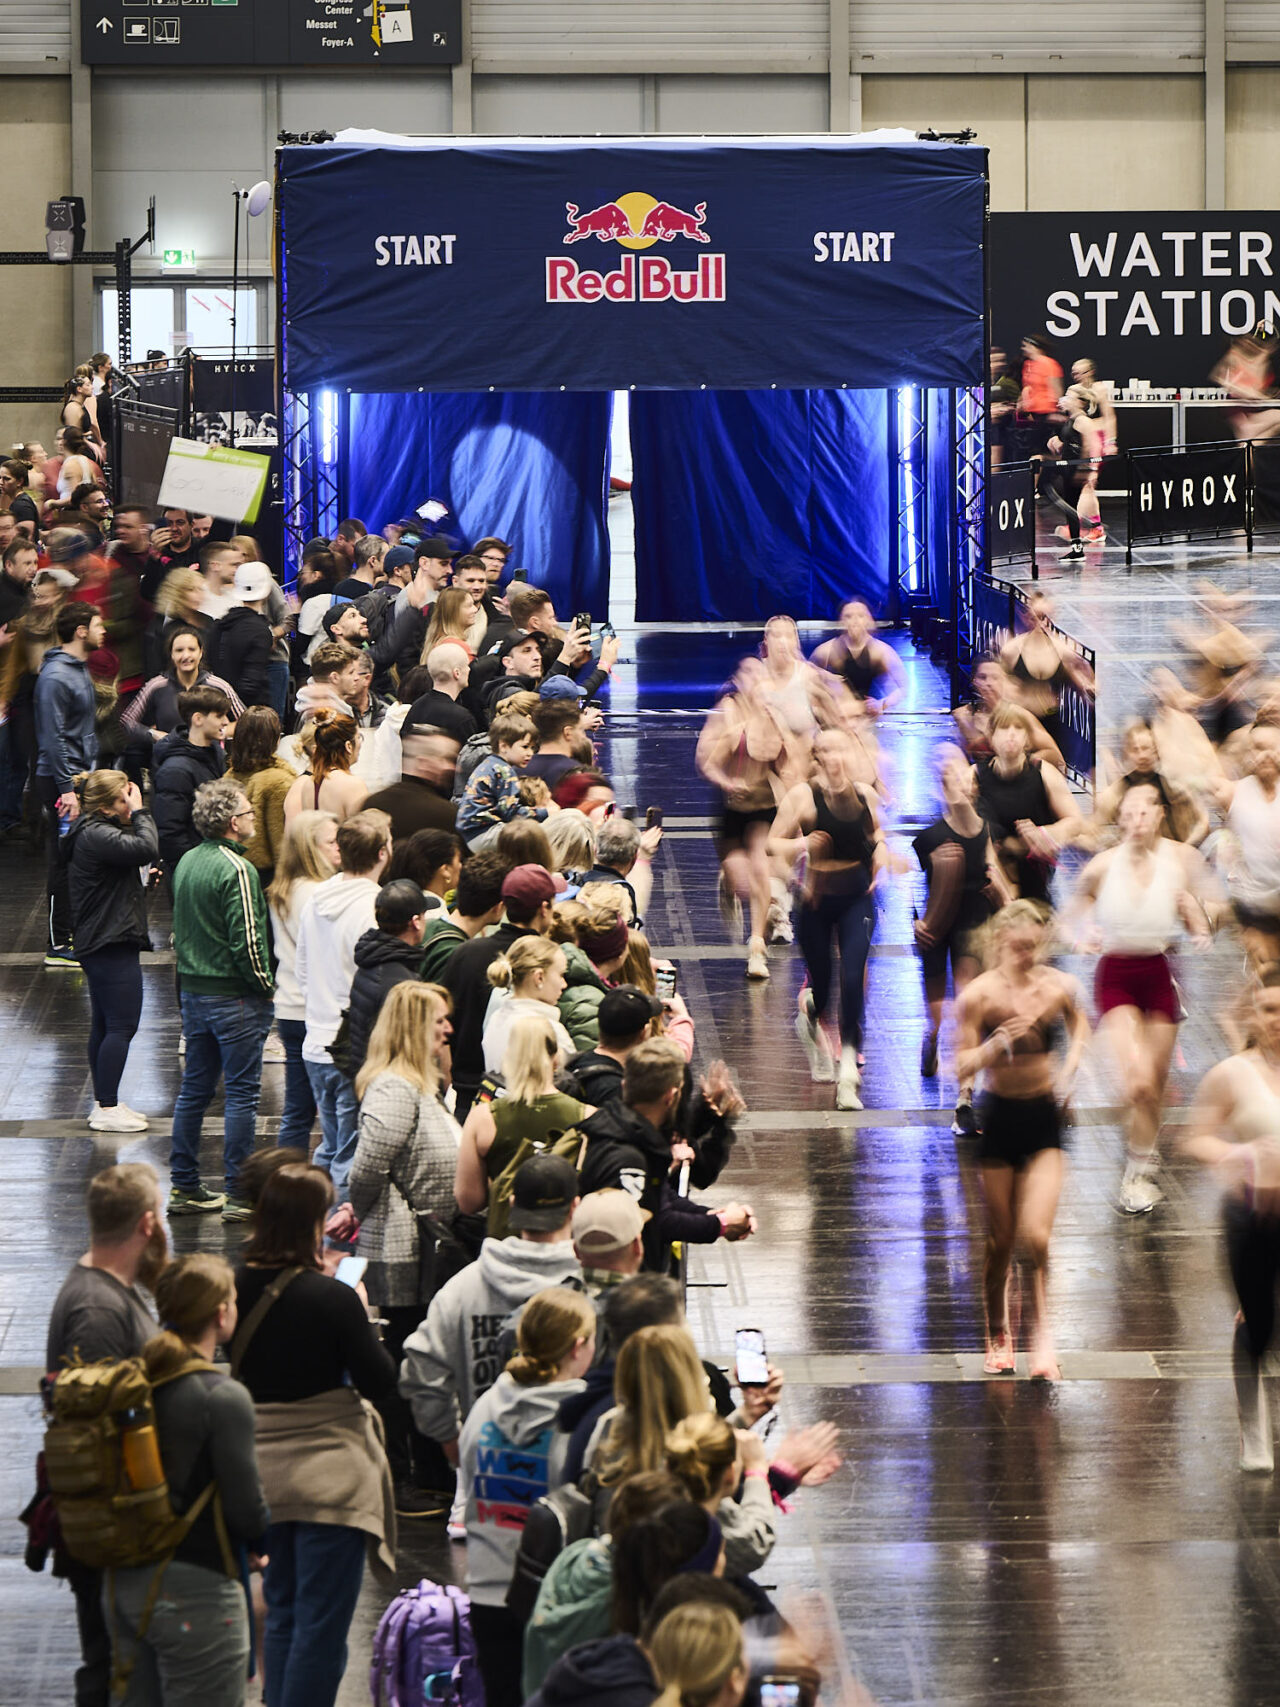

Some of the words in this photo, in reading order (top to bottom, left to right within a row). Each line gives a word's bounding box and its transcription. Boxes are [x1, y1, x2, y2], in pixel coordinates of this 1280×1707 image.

[325, 6, 353, 15] Center
[392, 20, 402, 33] A
[321, 37, 354, 48] Foyer-A
[375, 234, 457, 266] START
[813, 231, 895, 263] START
[1069, 231, 1274, 278] WATER
[545, 254, 636, 303] Red
[639, 254, 726, 303] Bull
[1140, 473, 1237, 512] HYROX
